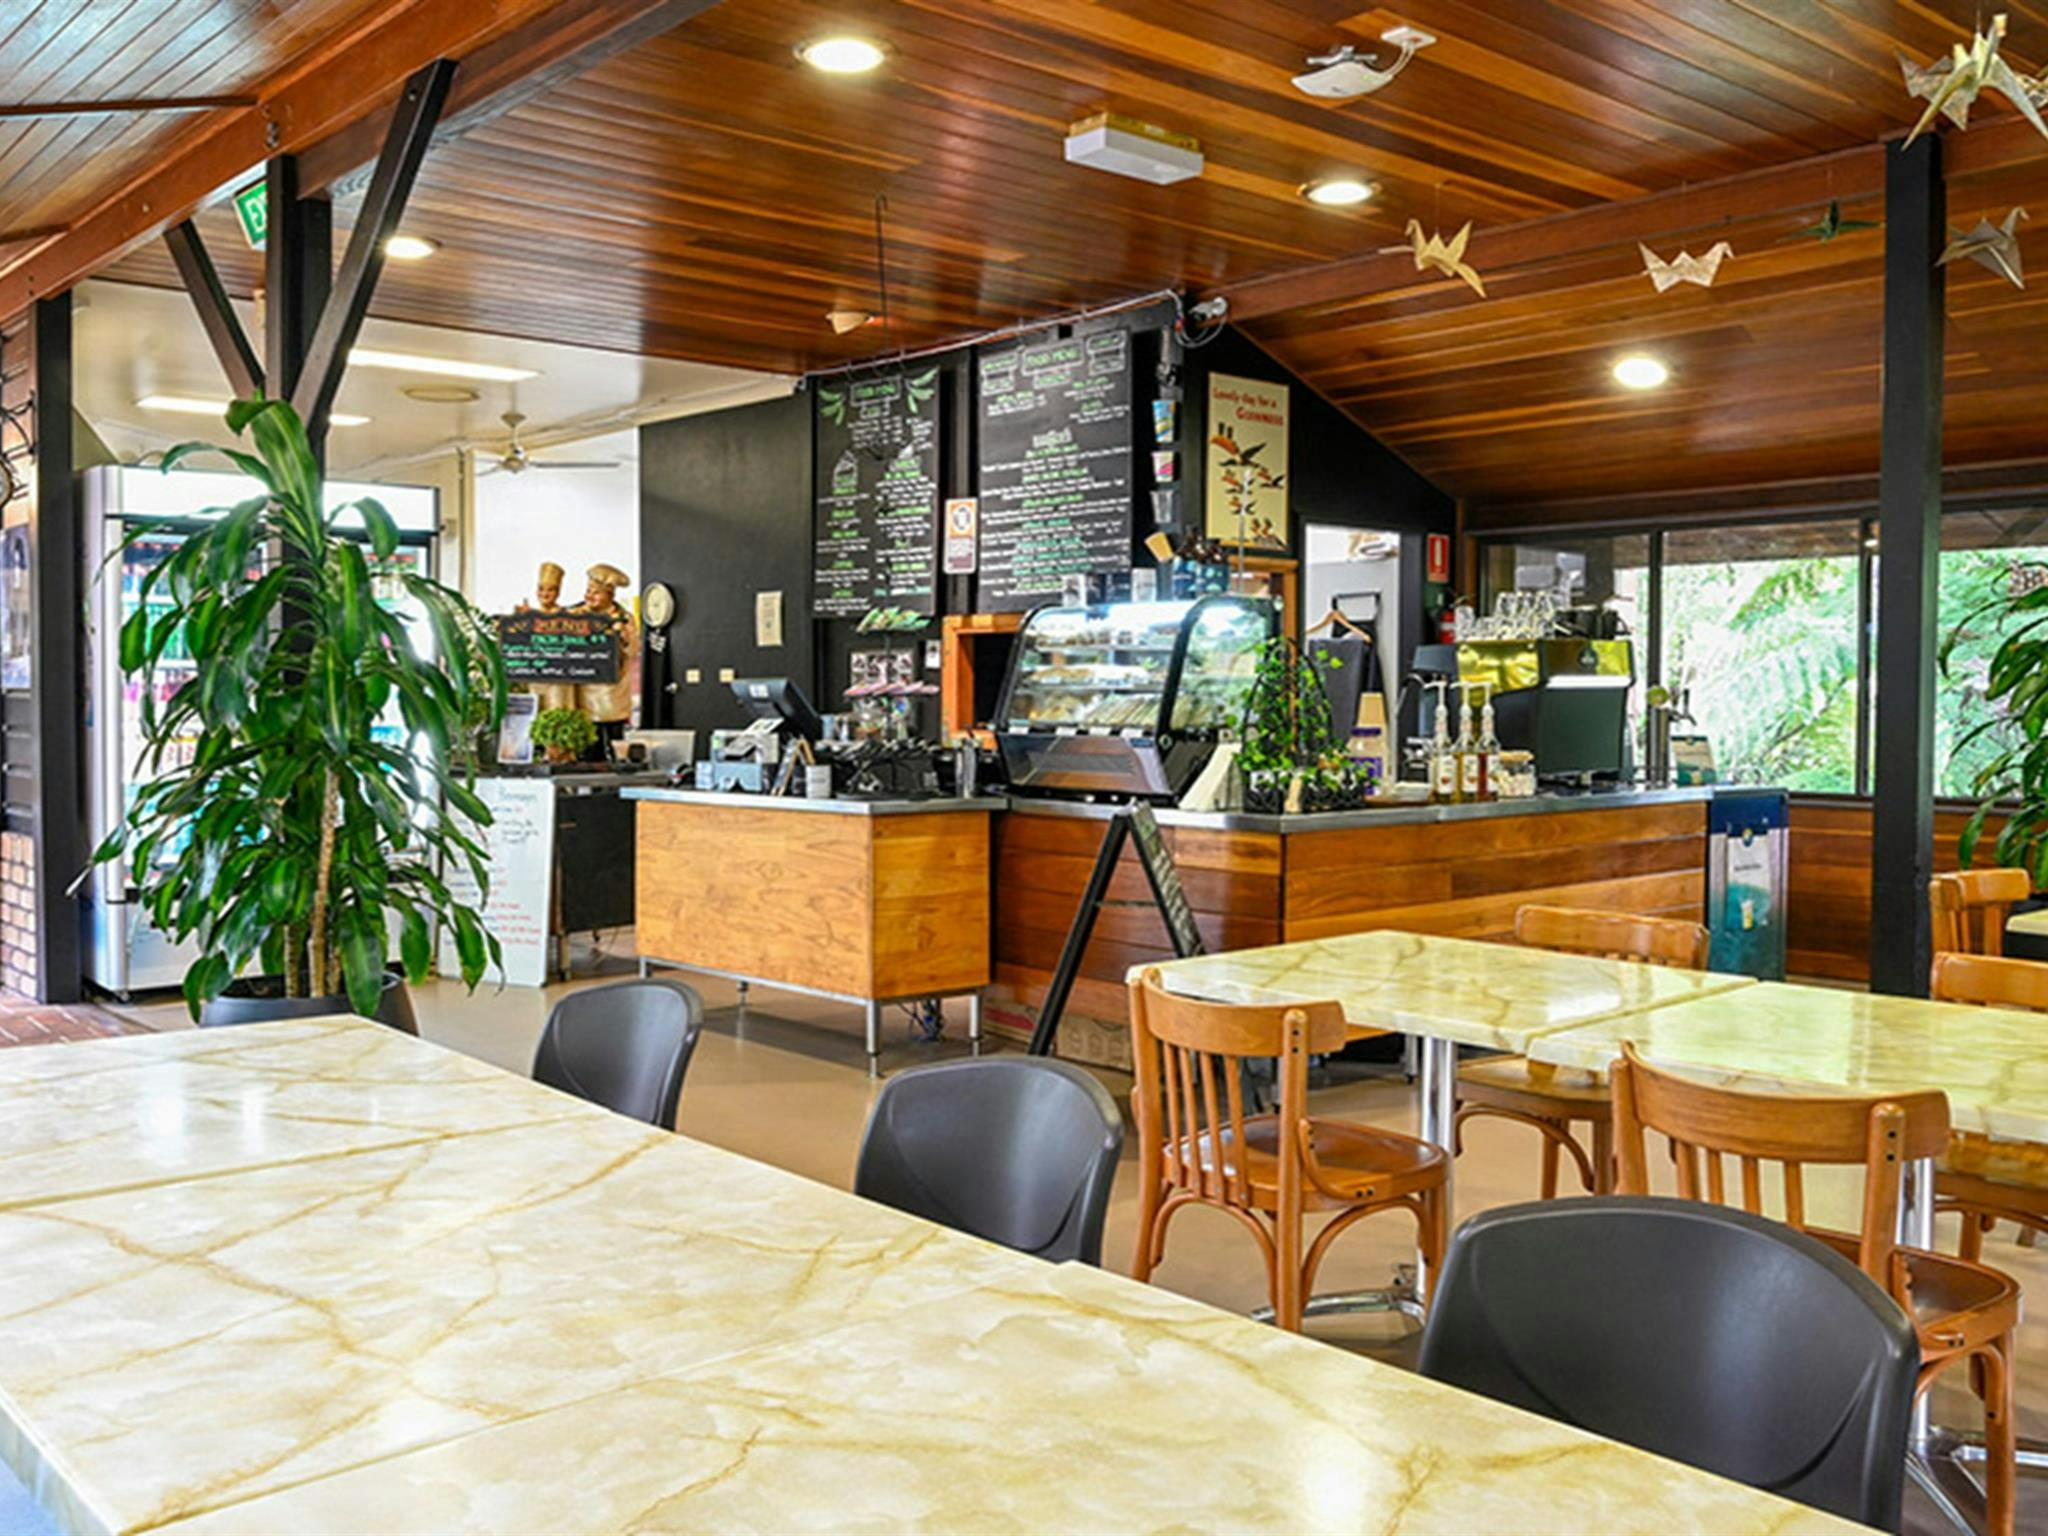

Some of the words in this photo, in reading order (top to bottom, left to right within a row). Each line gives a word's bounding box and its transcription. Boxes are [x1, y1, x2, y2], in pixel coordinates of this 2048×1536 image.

[1213, 386, 1240, 403] Lovely
[1242, 392, 1256, 407] day
[1257, 394, 1270, 407] for
